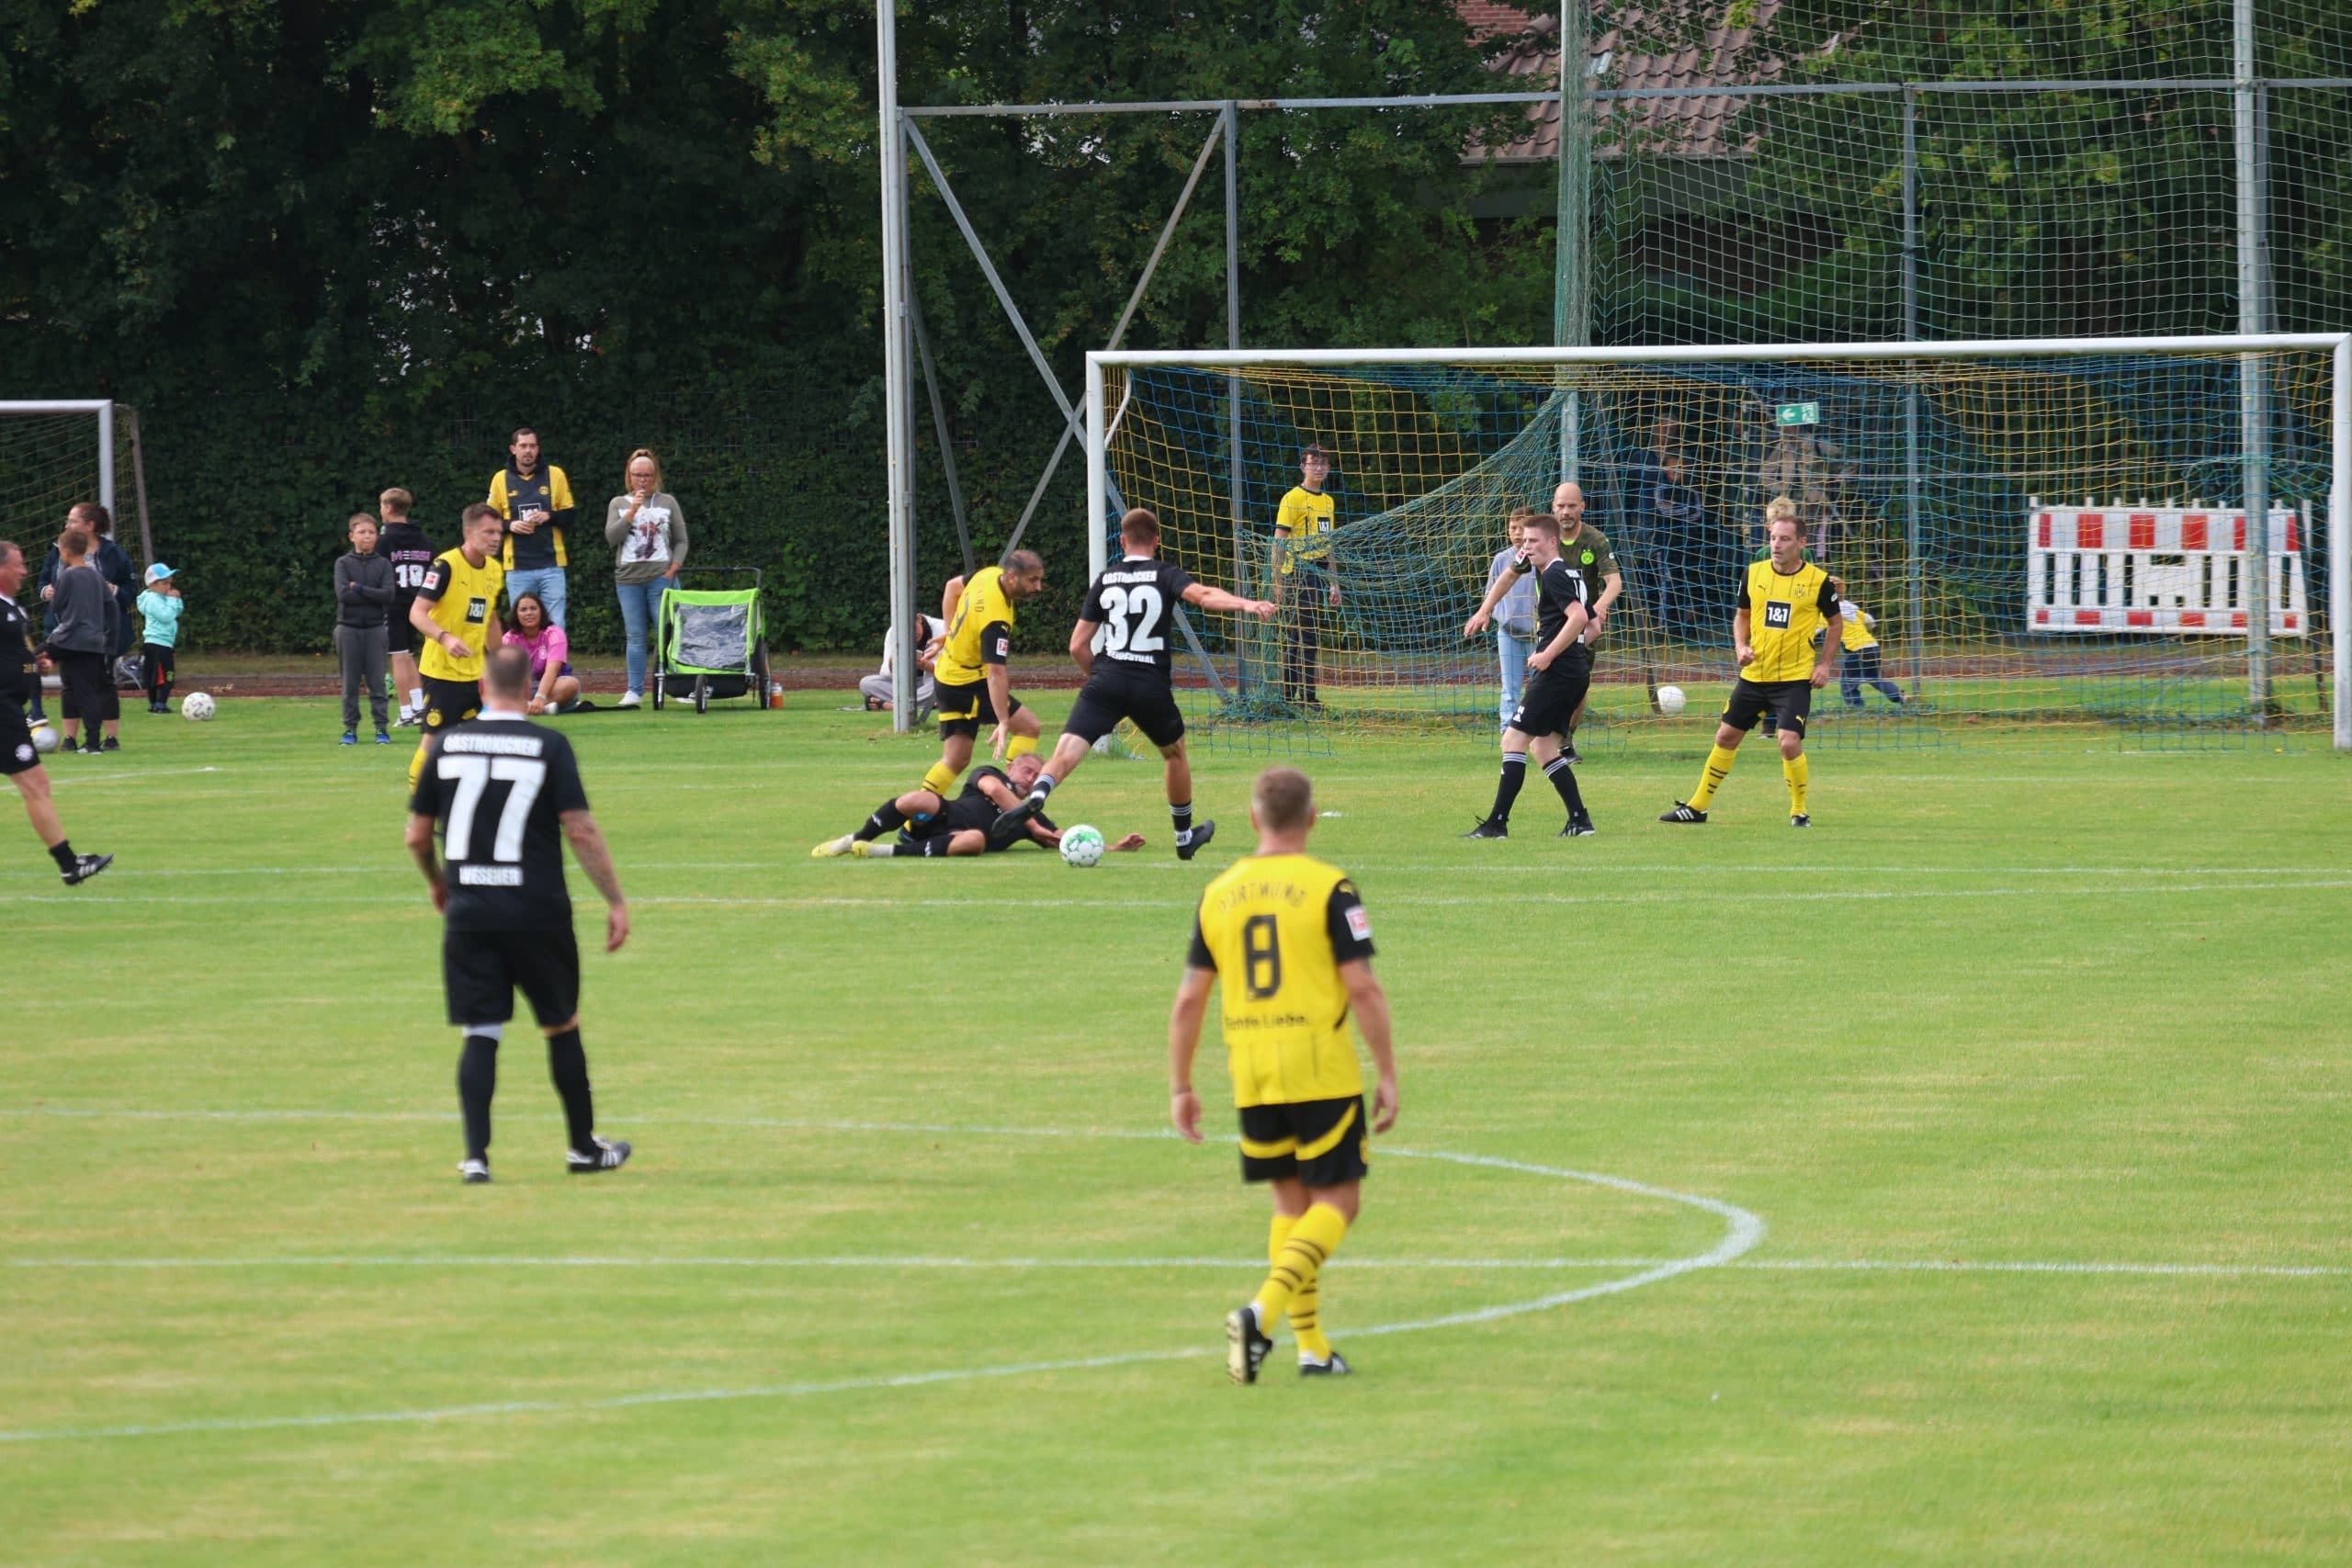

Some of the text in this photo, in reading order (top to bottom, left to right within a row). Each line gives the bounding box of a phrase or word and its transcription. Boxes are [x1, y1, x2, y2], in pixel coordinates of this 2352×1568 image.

[390, 550, 431, 562] MESSI
[395, 564, 424, 588] 10
[1099, 584, 1164, 652] 32
[1768, 606, 1789, 623] 1&1
[437, 754, 547, 862] 77
[1243, 913, 1281, 1002] 8
